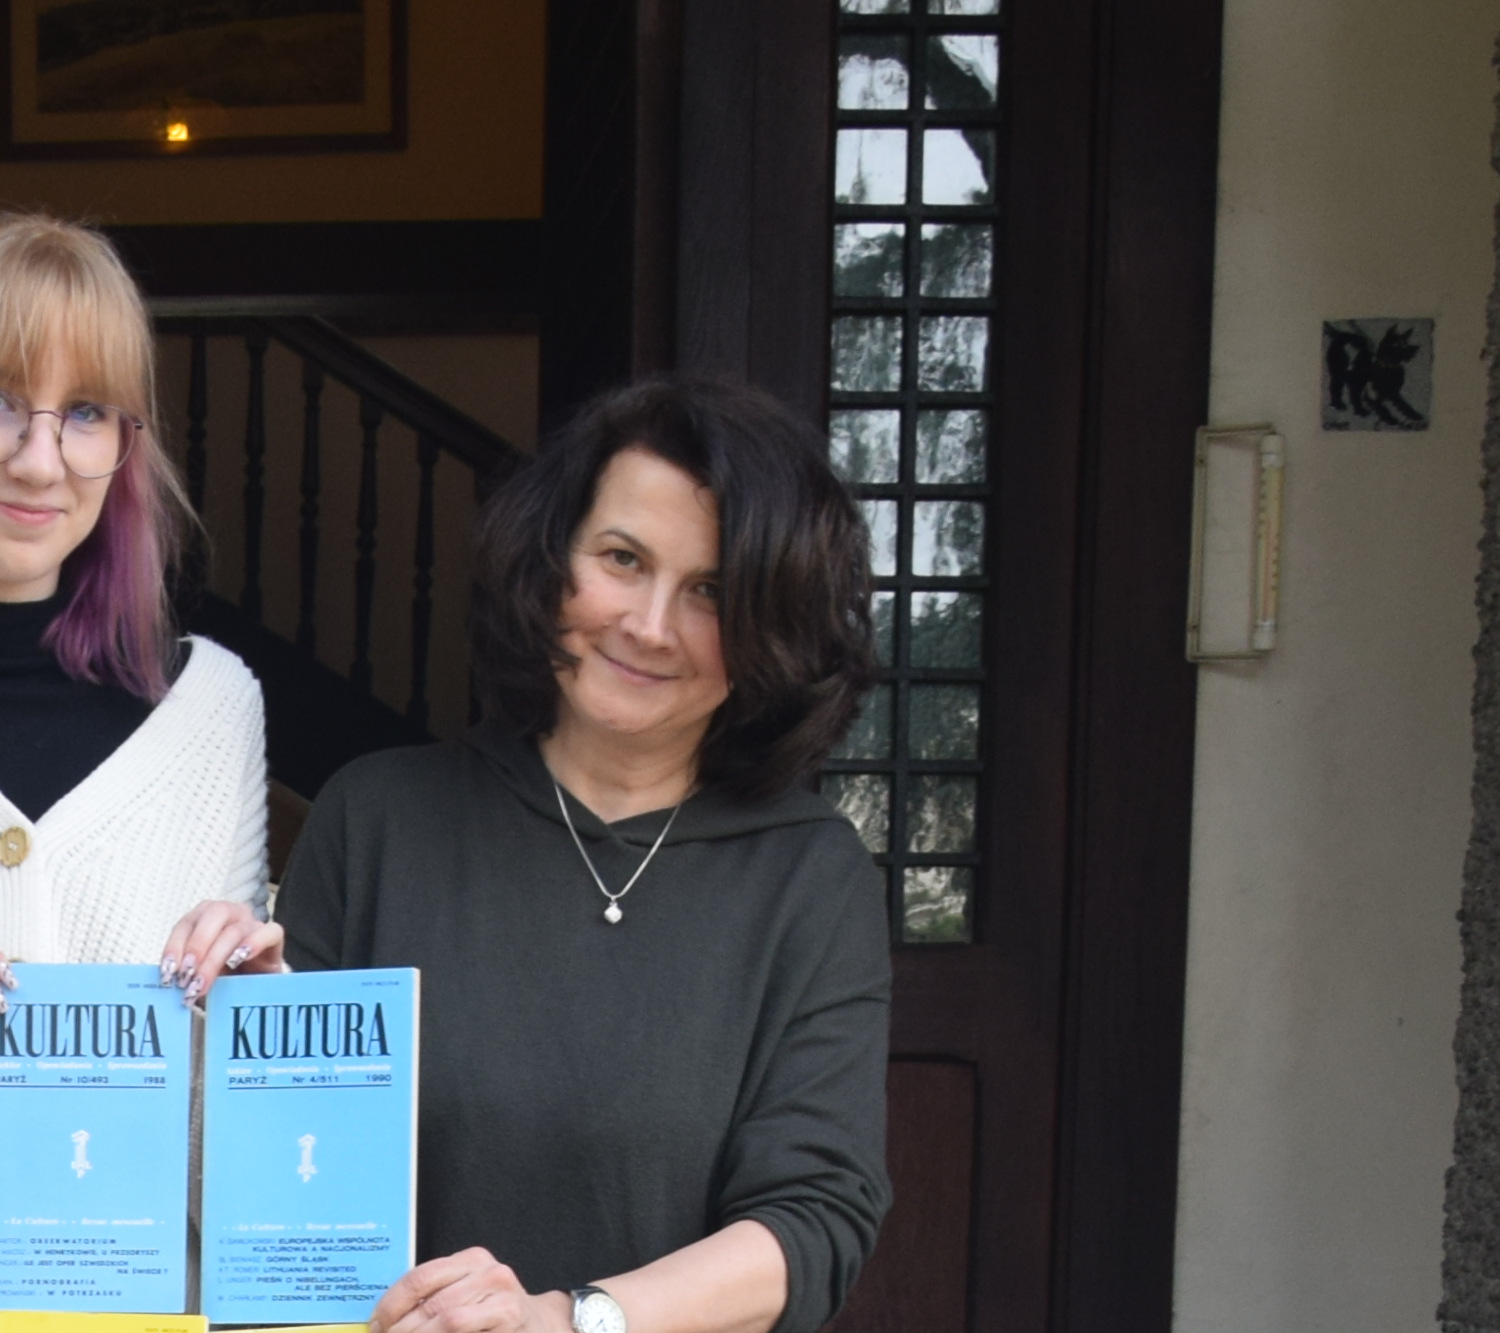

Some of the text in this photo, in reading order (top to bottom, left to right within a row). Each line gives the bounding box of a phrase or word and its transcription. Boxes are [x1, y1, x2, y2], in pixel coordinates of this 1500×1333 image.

[228, 1002, 392, 1060] KULTURA
[77, 1076, 109, 1084] 10/493
[144, 1076, 166, 1084] 1988
[229, 1076, 268, 1085] PARYŻ
[310, 1075, 339, 1083] 4/511
[366, 1074, 392, 1082] 1990
